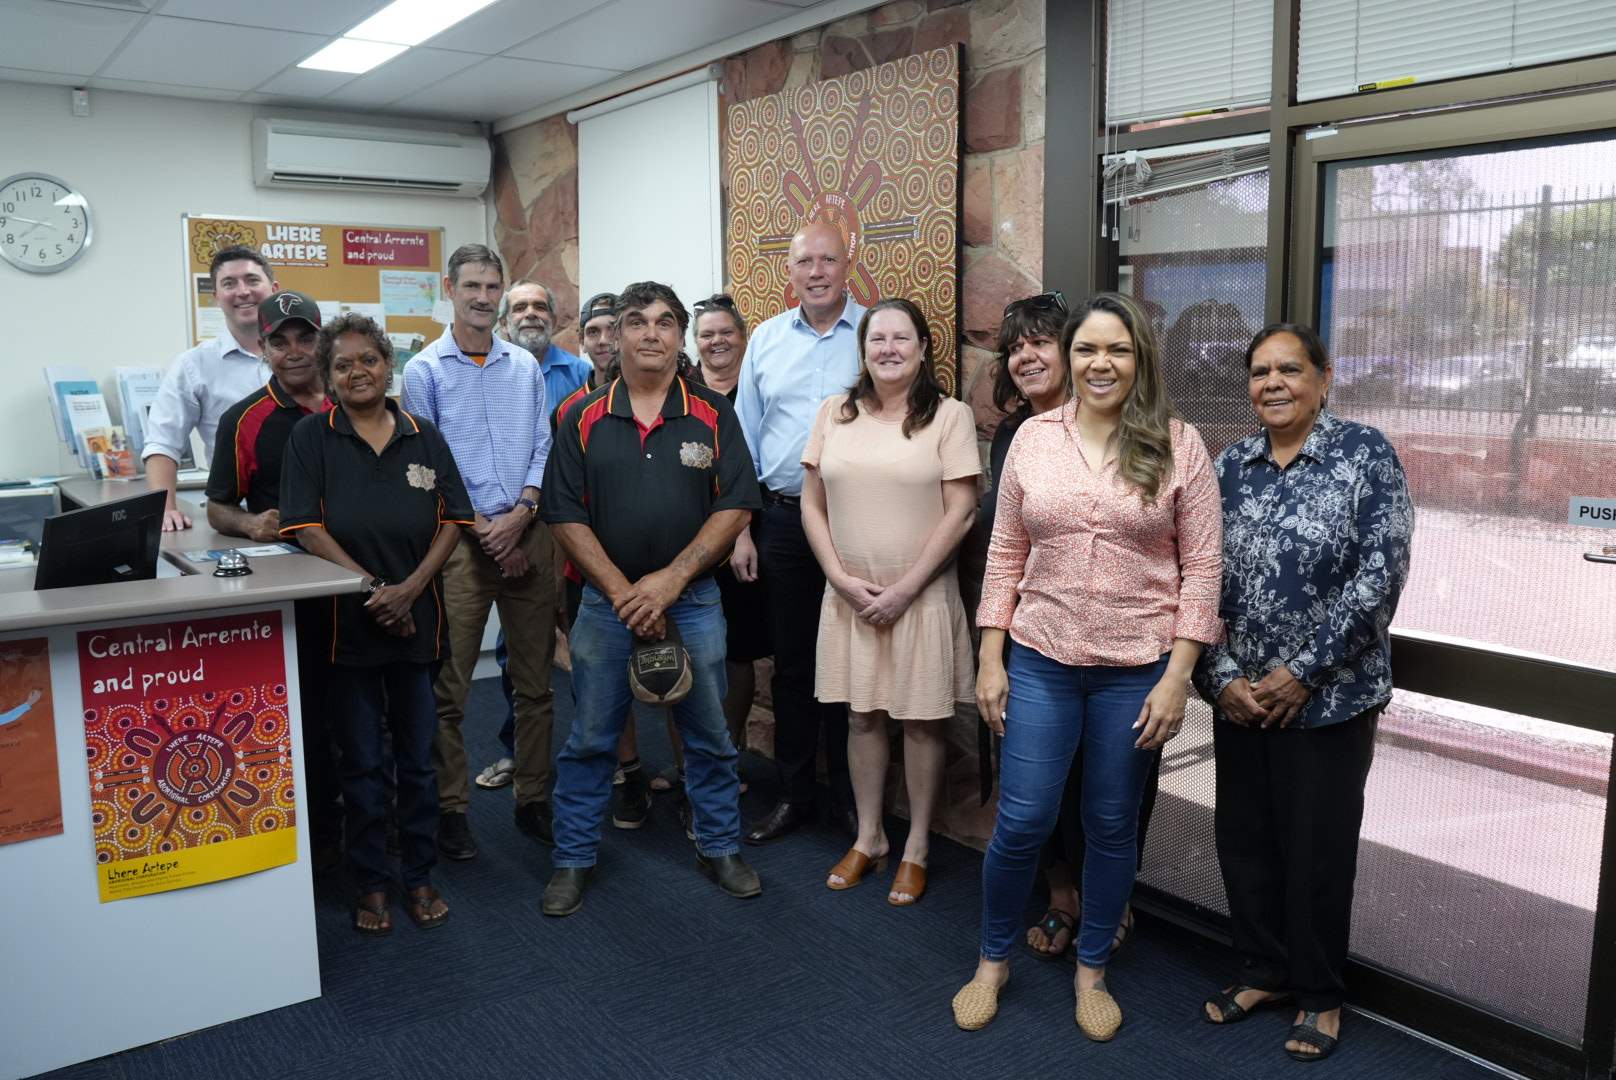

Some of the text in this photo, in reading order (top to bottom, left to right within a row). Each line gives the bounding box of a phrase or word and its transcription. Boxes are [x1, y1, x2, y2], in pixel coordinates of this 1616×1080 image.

[16, 191, 26, 202] 11
[31, 187, 42, 198] 12
[3, 202, 15, 213] 10
[64, 205, 71, 213] 2
[72, 218, 78, 229] 3
[6, 233, 15, 244] 8
[266, 224, 321, 242] LHERE
[346, 231, 425, 246] Central Arrernte
[67, 234, 74, 244] 4
[21, 244, 29, 255] 7
[39, 248, 47, 259] 6
[56, 244, 62, 255] 5
[261, 243, 327, 260] ARTEPE
[347, 248, 395, 264] and proud
[88, 619, 272, 658] Central Arrernte
[92, 658, 204, 697] and proud
[165, 734, 189, 752] LHERE
[157, 779, 190, 804] ABORIGINAL
[107, 860, 179, 880] Lhere Artepe
